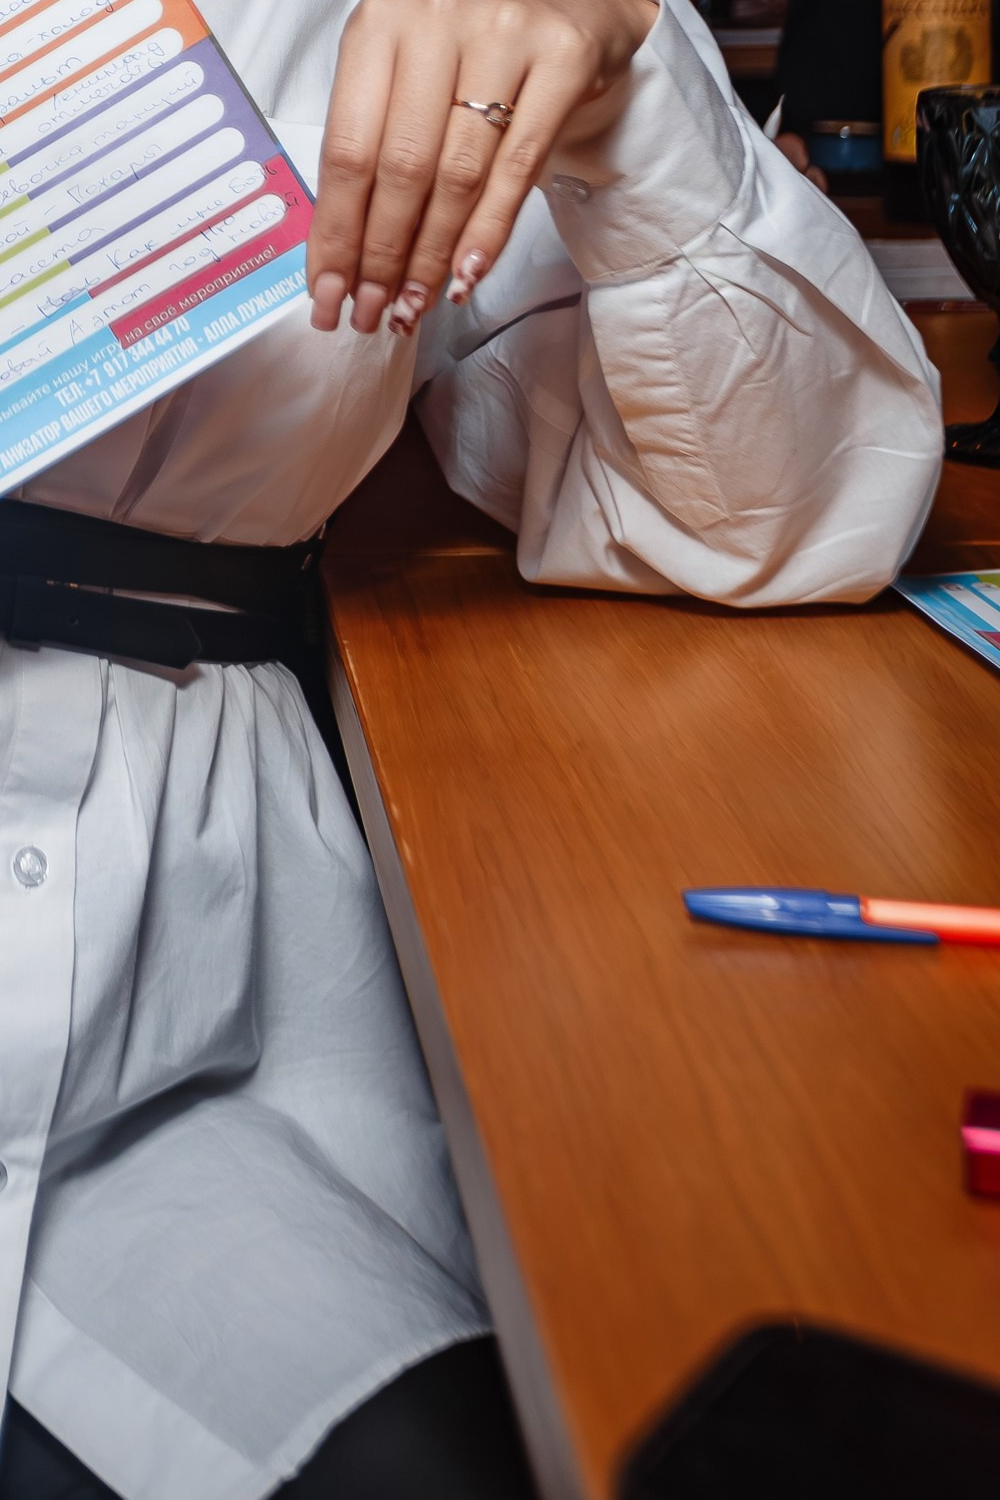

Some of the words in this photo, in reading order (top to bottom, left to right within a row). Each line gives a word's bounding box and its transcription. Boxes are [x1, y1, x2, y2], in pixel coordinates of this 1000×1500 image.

[51, 359, 89, 388] нашу
[90, 338, 124, 365] игру
[123, 325, 143, 342] на
[141, 303, 178, 331] своё
[176, 243, 277, 310] мероприятие!
[54, 379, 86, 407] ТЕЛ:
[101, 351, 131, 378] 917
[126, 336, 156, 363] 344
[151, 324, 176, 348] 44
[170, 315, 191, 336] 70
[58, 388, 114, 431] ВАШЕГО
[107, 336, 200, 401] МЕРОПРИЯТИЯ
[201, 310, 242, 343] АЛЛА
